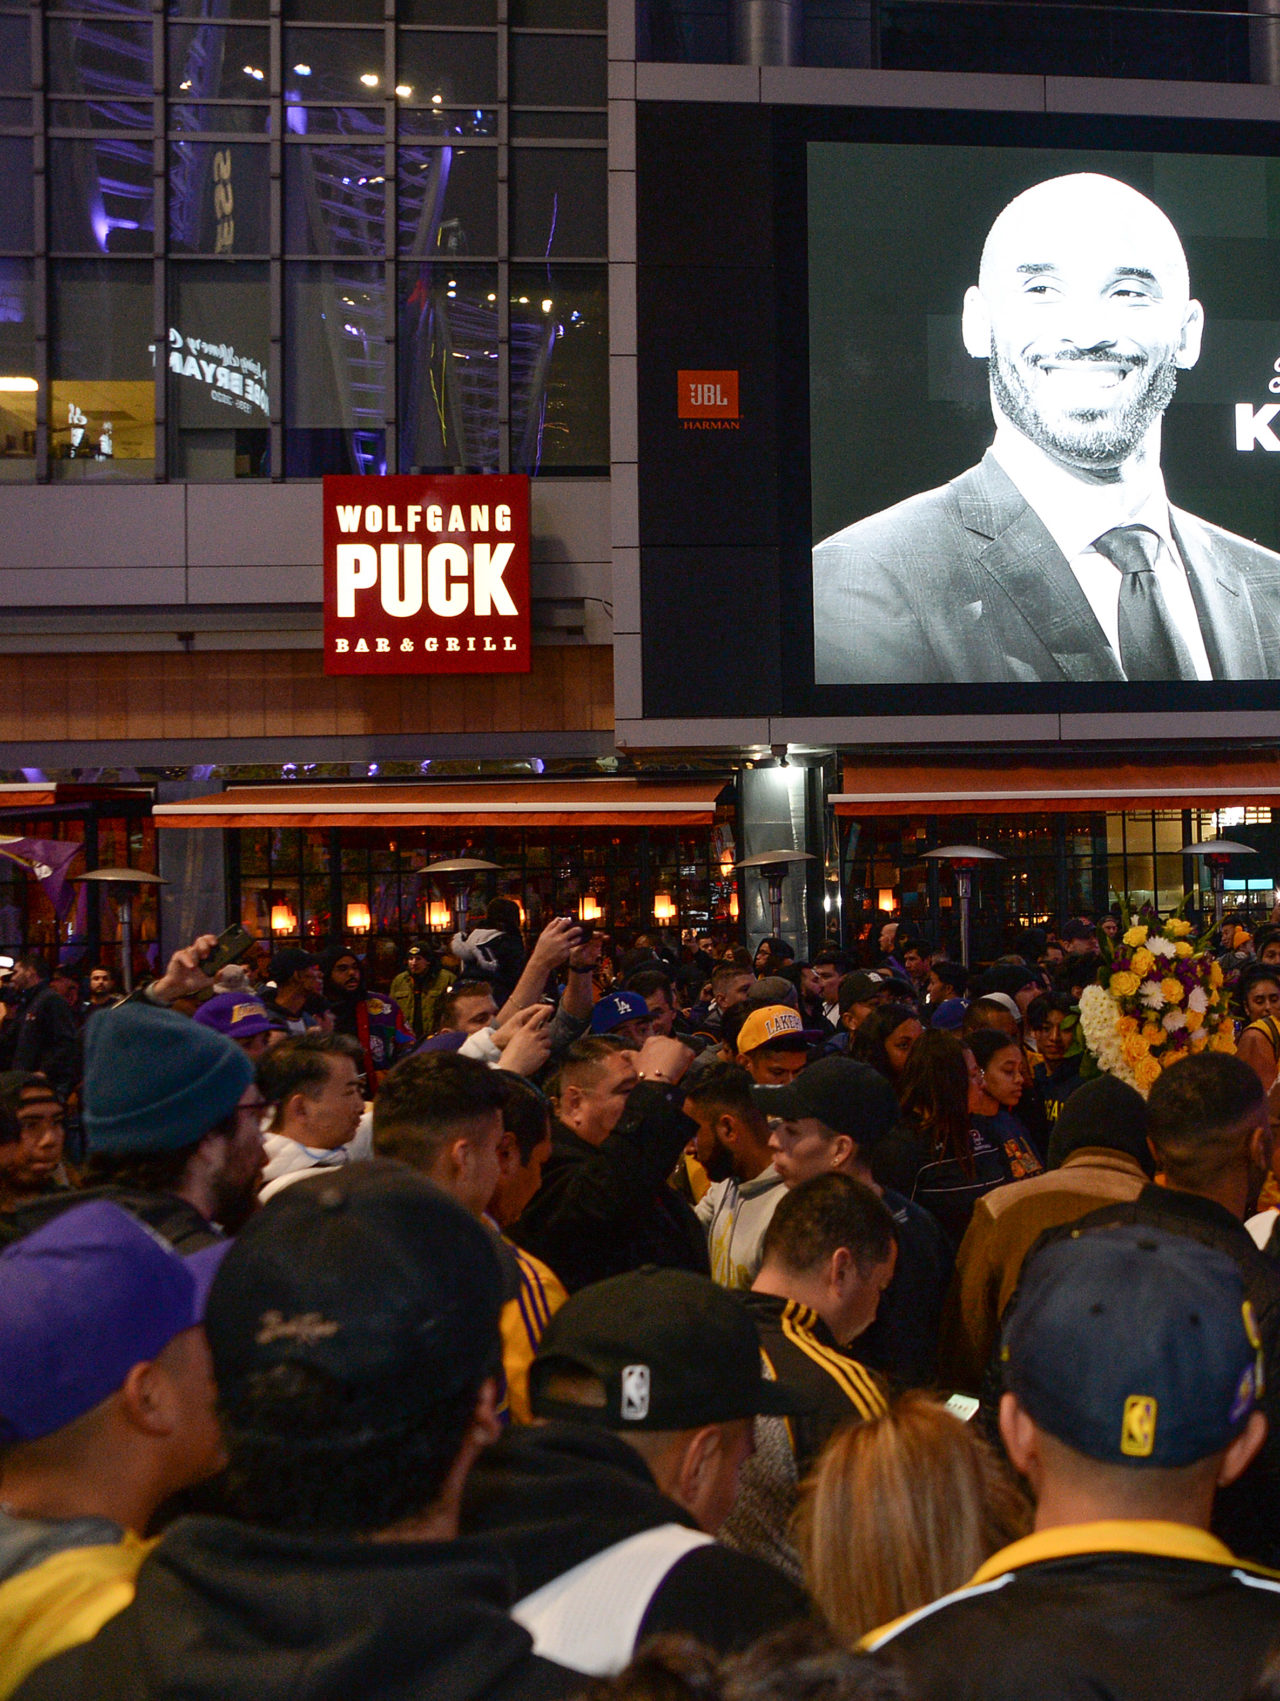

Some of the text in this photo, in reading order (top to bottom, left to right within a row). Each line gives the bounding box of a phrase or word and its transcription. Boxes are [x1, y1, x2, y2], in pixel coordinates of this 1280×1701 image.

[688, 383, 729, 406] JBL
[682, 420, 741, 430] HARMAN
[336, 504, 511, 533] WOLFGANG
[336, 543, 519, 618] PUCK
[612, 996, 632, 1015] LA
